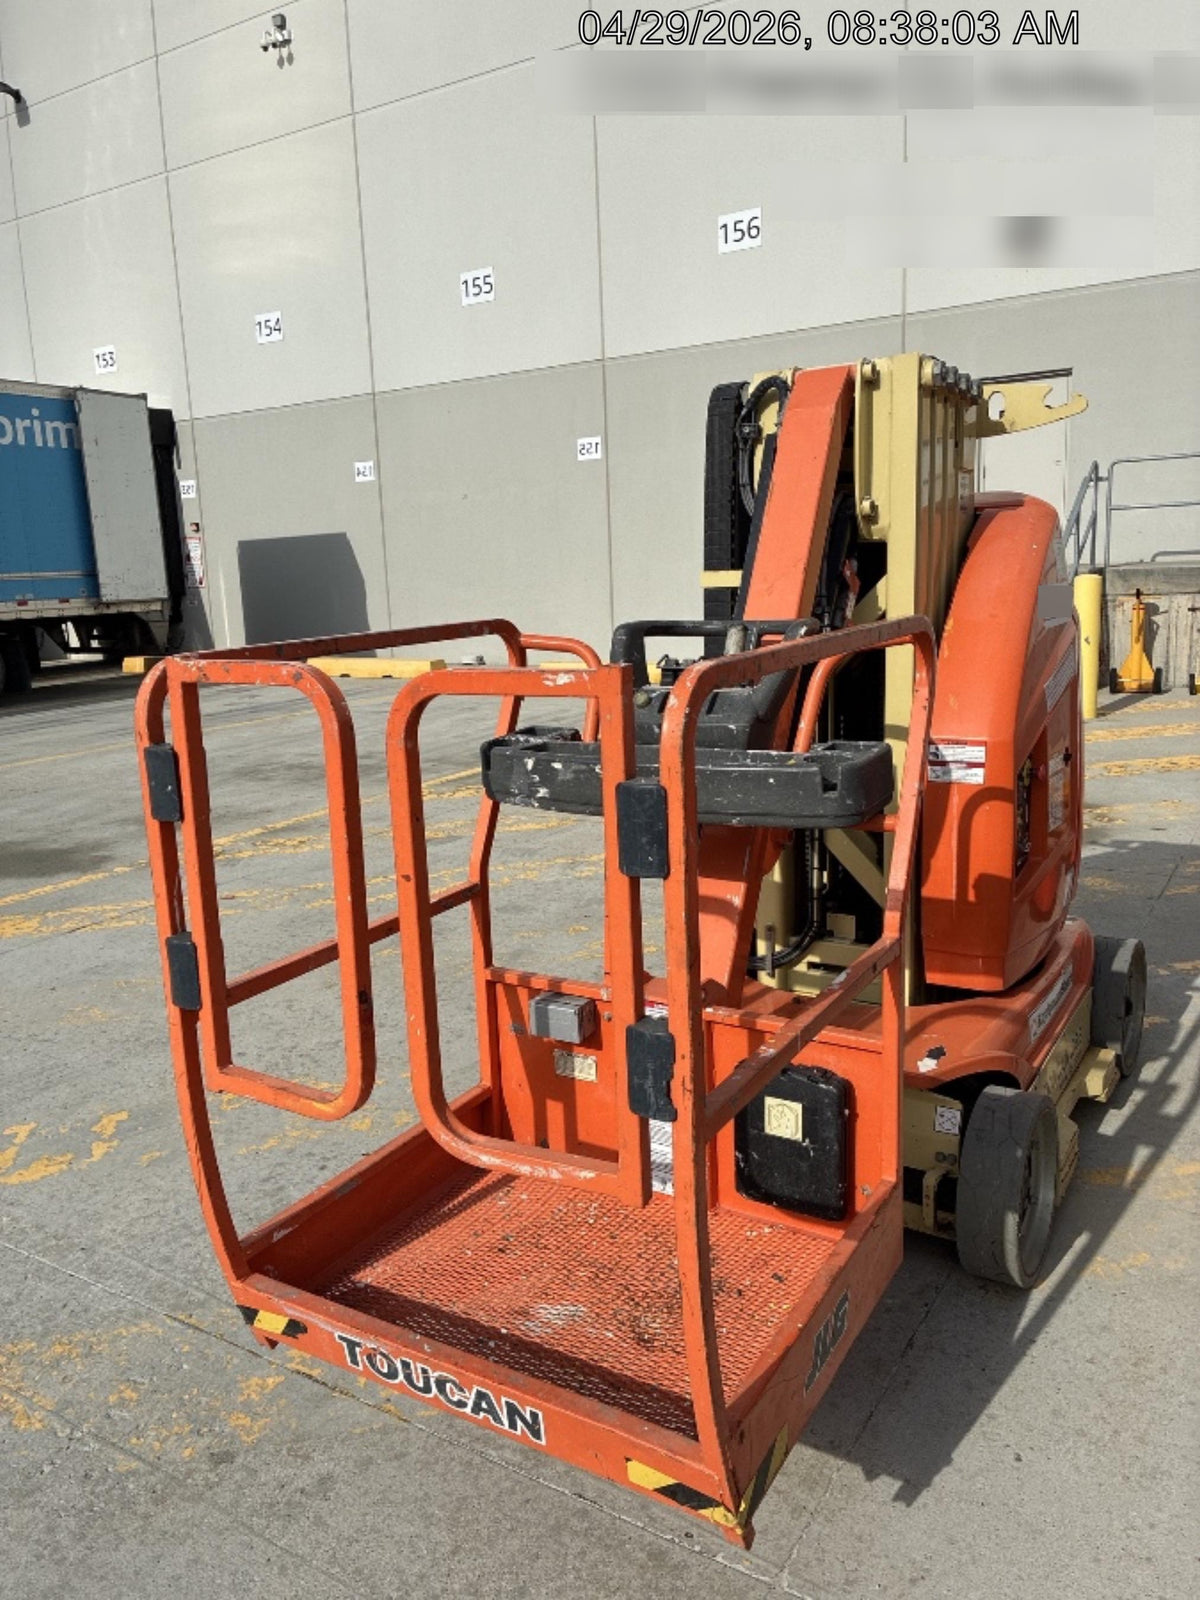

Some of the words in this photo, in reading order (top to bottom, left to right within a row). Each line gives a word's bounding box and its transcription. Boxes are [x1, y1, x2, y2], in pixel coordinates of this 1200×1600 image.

[719, 216, 760, 244] 156
[461, 274, 493, 297] 155
[256, 318, 281, 336] 154
[95, 351, 116, 368] 153
[335, 1333, 545, 1444] TOUCAN
